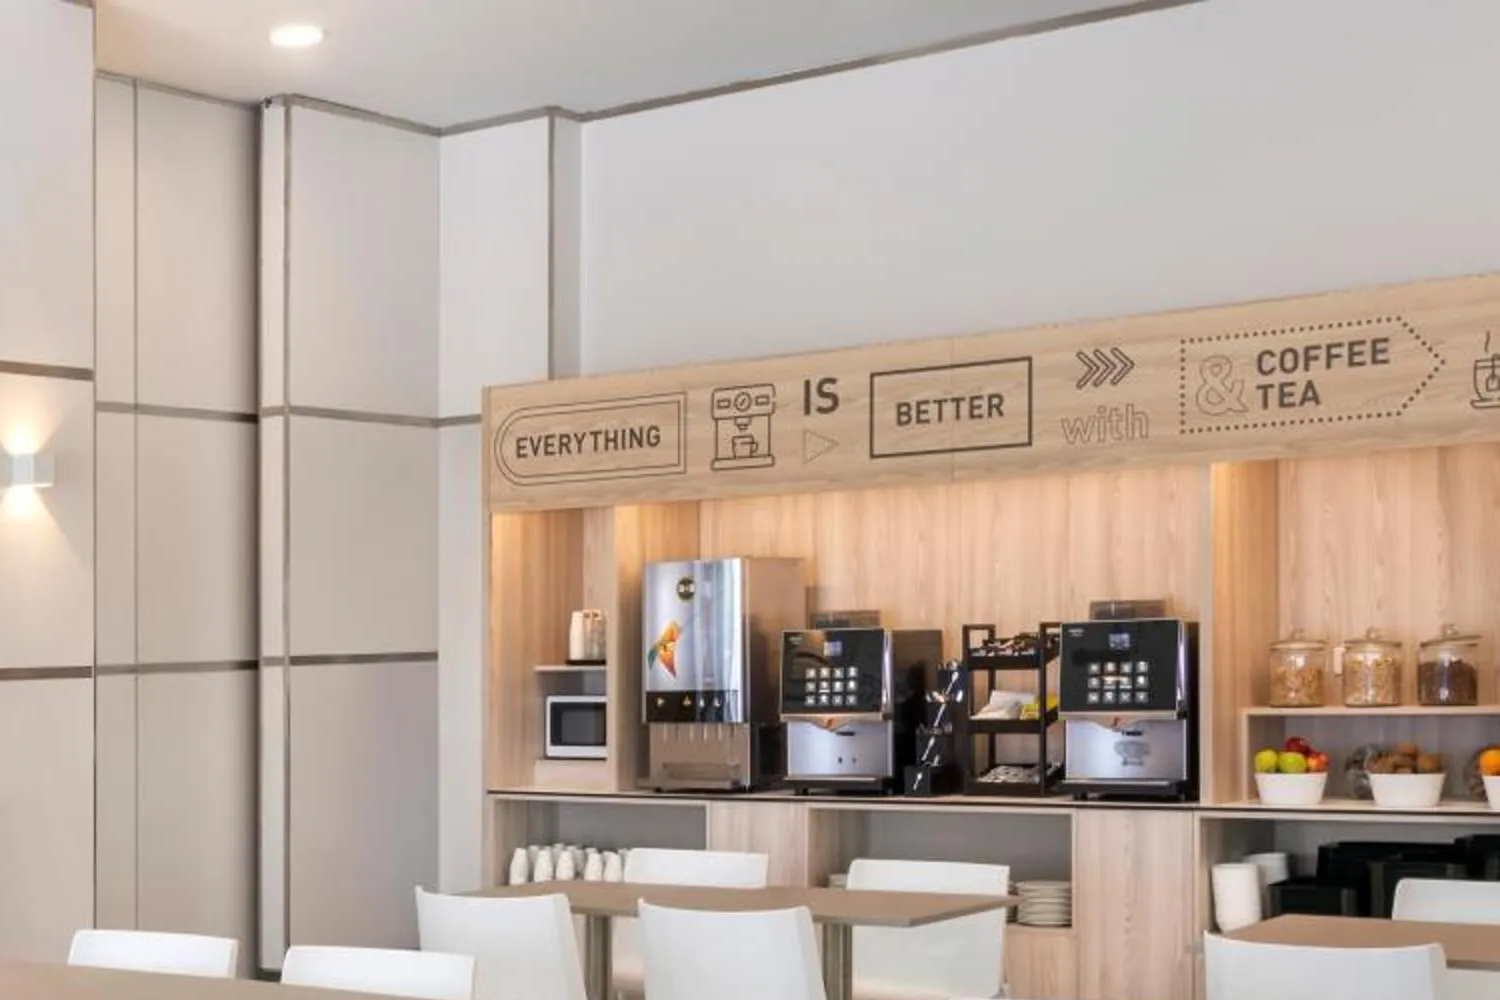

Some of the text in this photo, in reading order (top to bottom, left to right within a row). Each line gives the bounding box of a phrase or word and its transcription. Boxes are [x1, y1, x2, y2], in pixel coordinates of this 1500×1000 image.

[1255, 336, 1392, 378] COFFEE
[801, 376, 841, 417] IS
[1195, 353, 1250, 417] &
[1255, 378, 1323, 411] TEA
[896, 392, 1006, 427] BETTER
[1060, 402, 1151, 446] with
[514, 424, 663, 460] EVERYTHING
